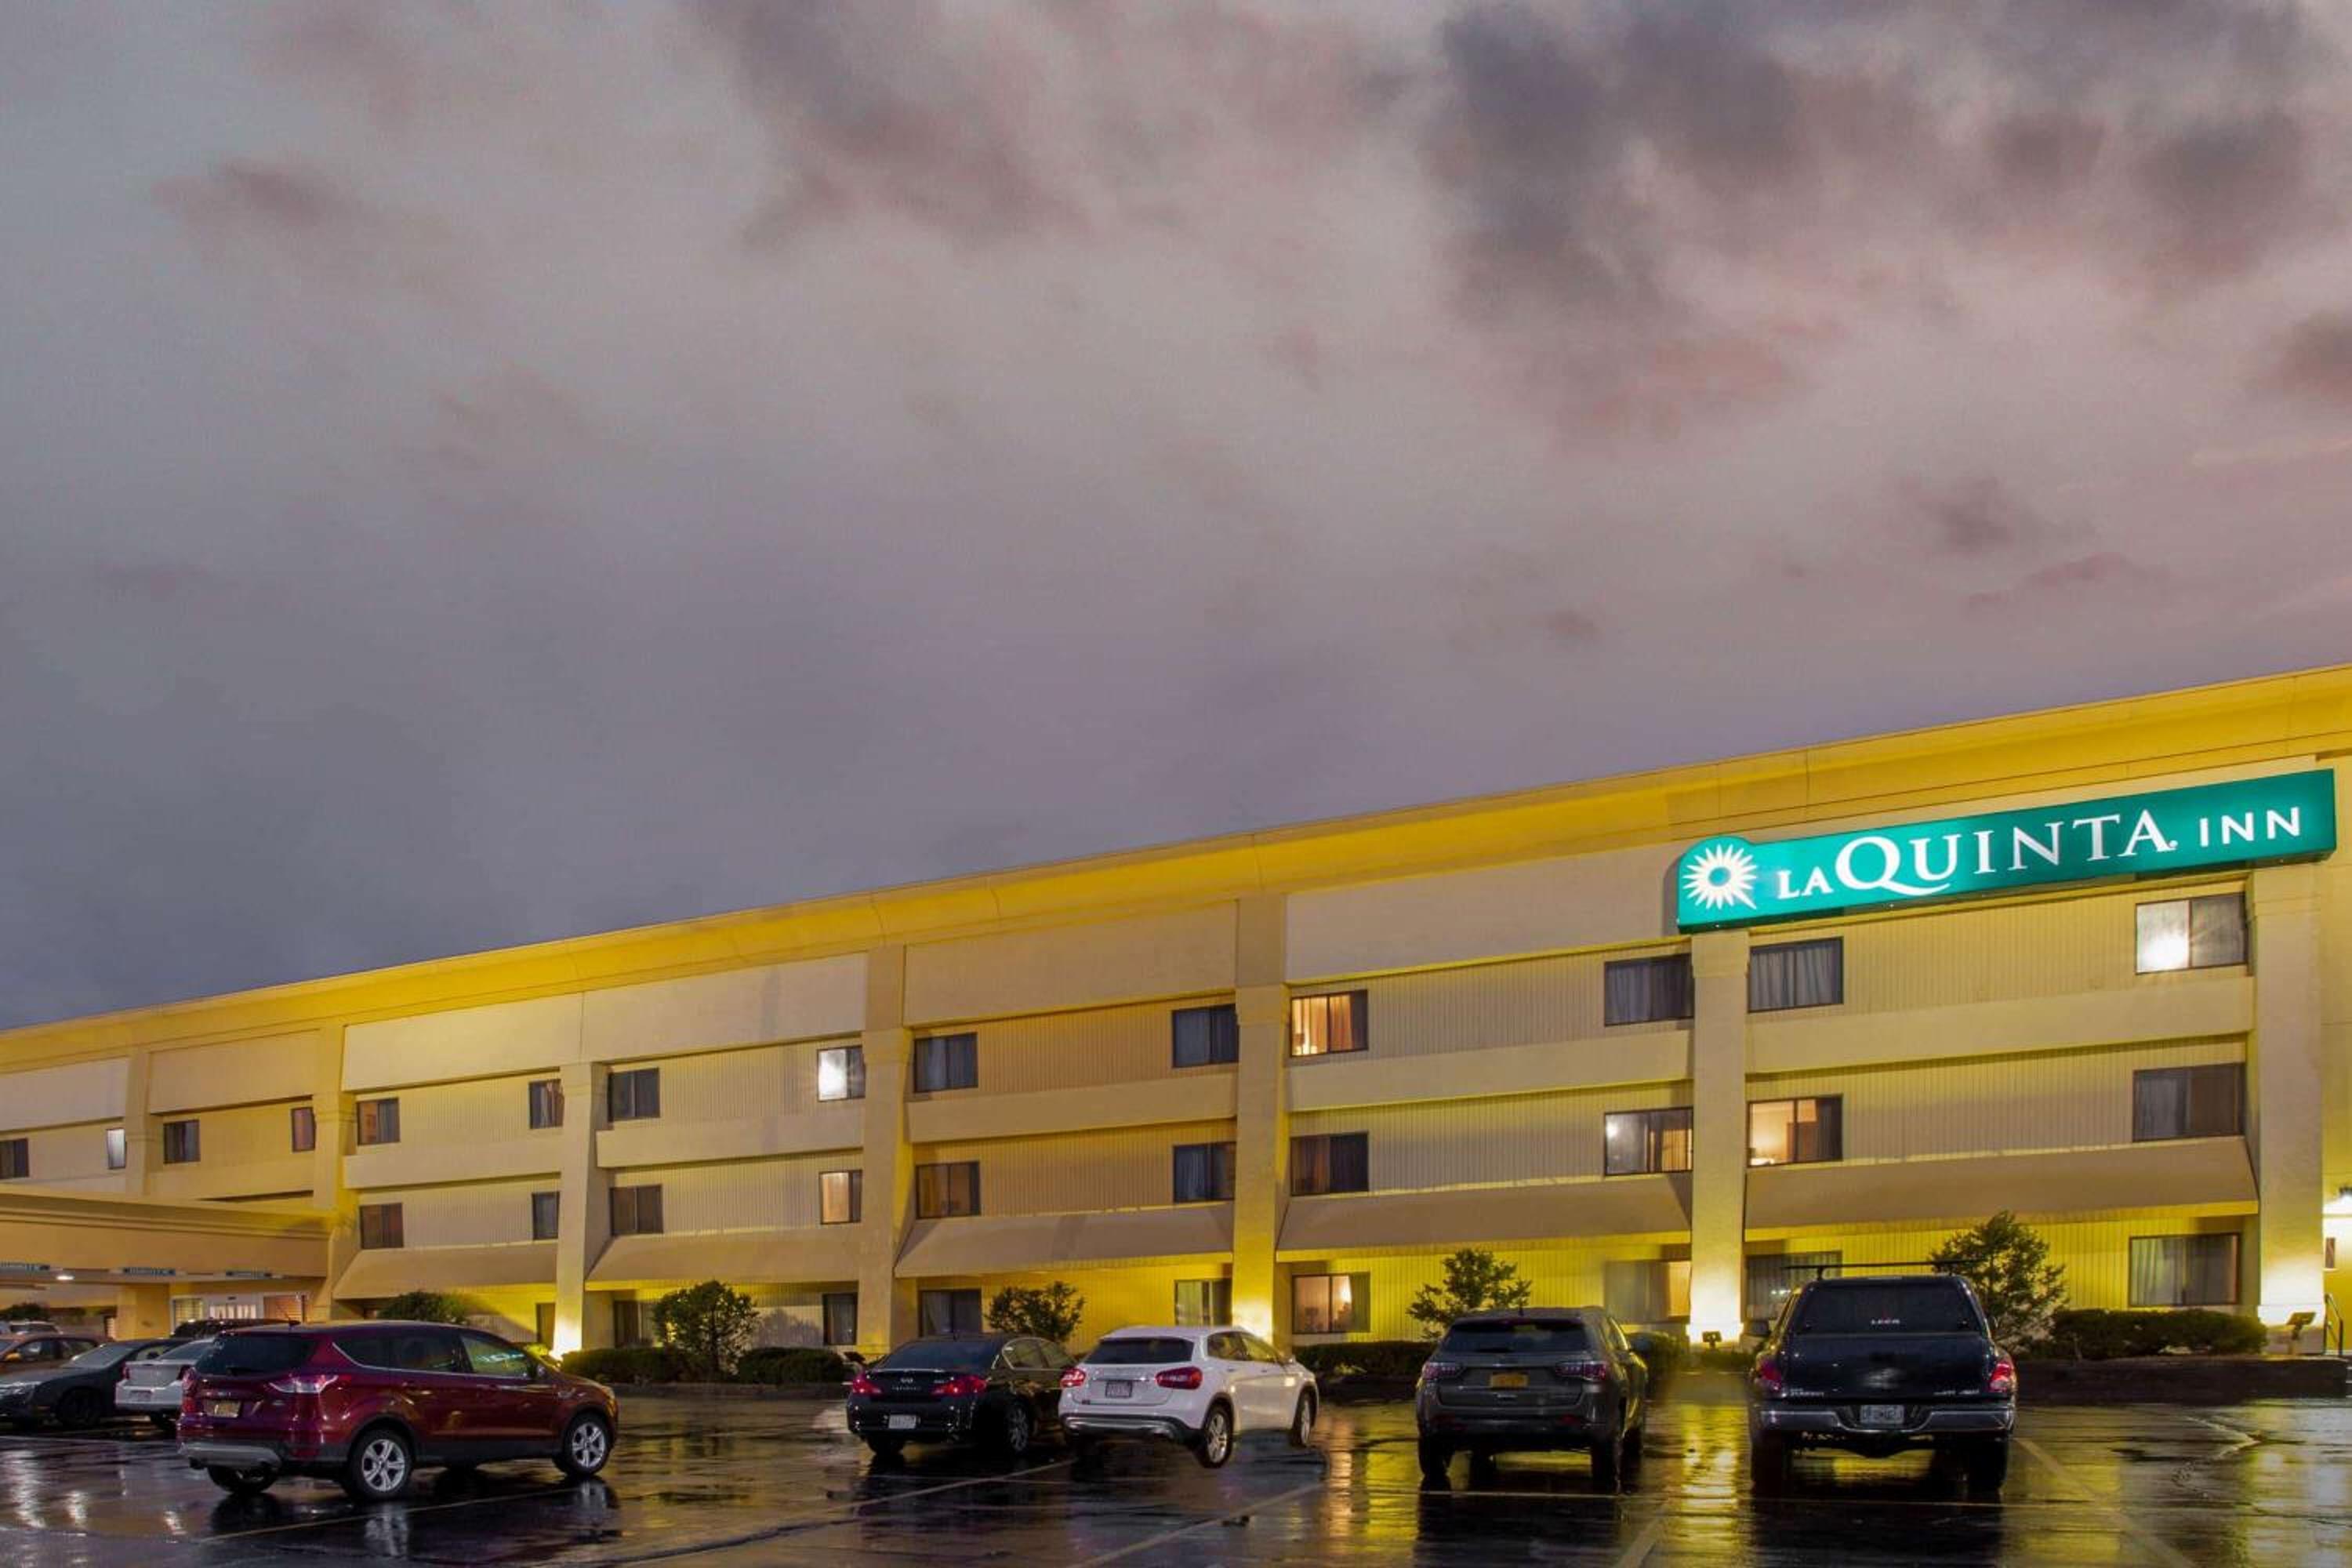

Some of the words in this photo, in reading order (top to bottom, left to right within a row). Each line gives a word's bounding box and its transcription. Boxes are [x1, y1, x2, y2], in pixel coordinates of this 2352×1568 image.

[1777, 866, 1834, 899] LA
[1835, 809, 2177, 895] QUINTA
[2199, 806, 2300, 848] INN
